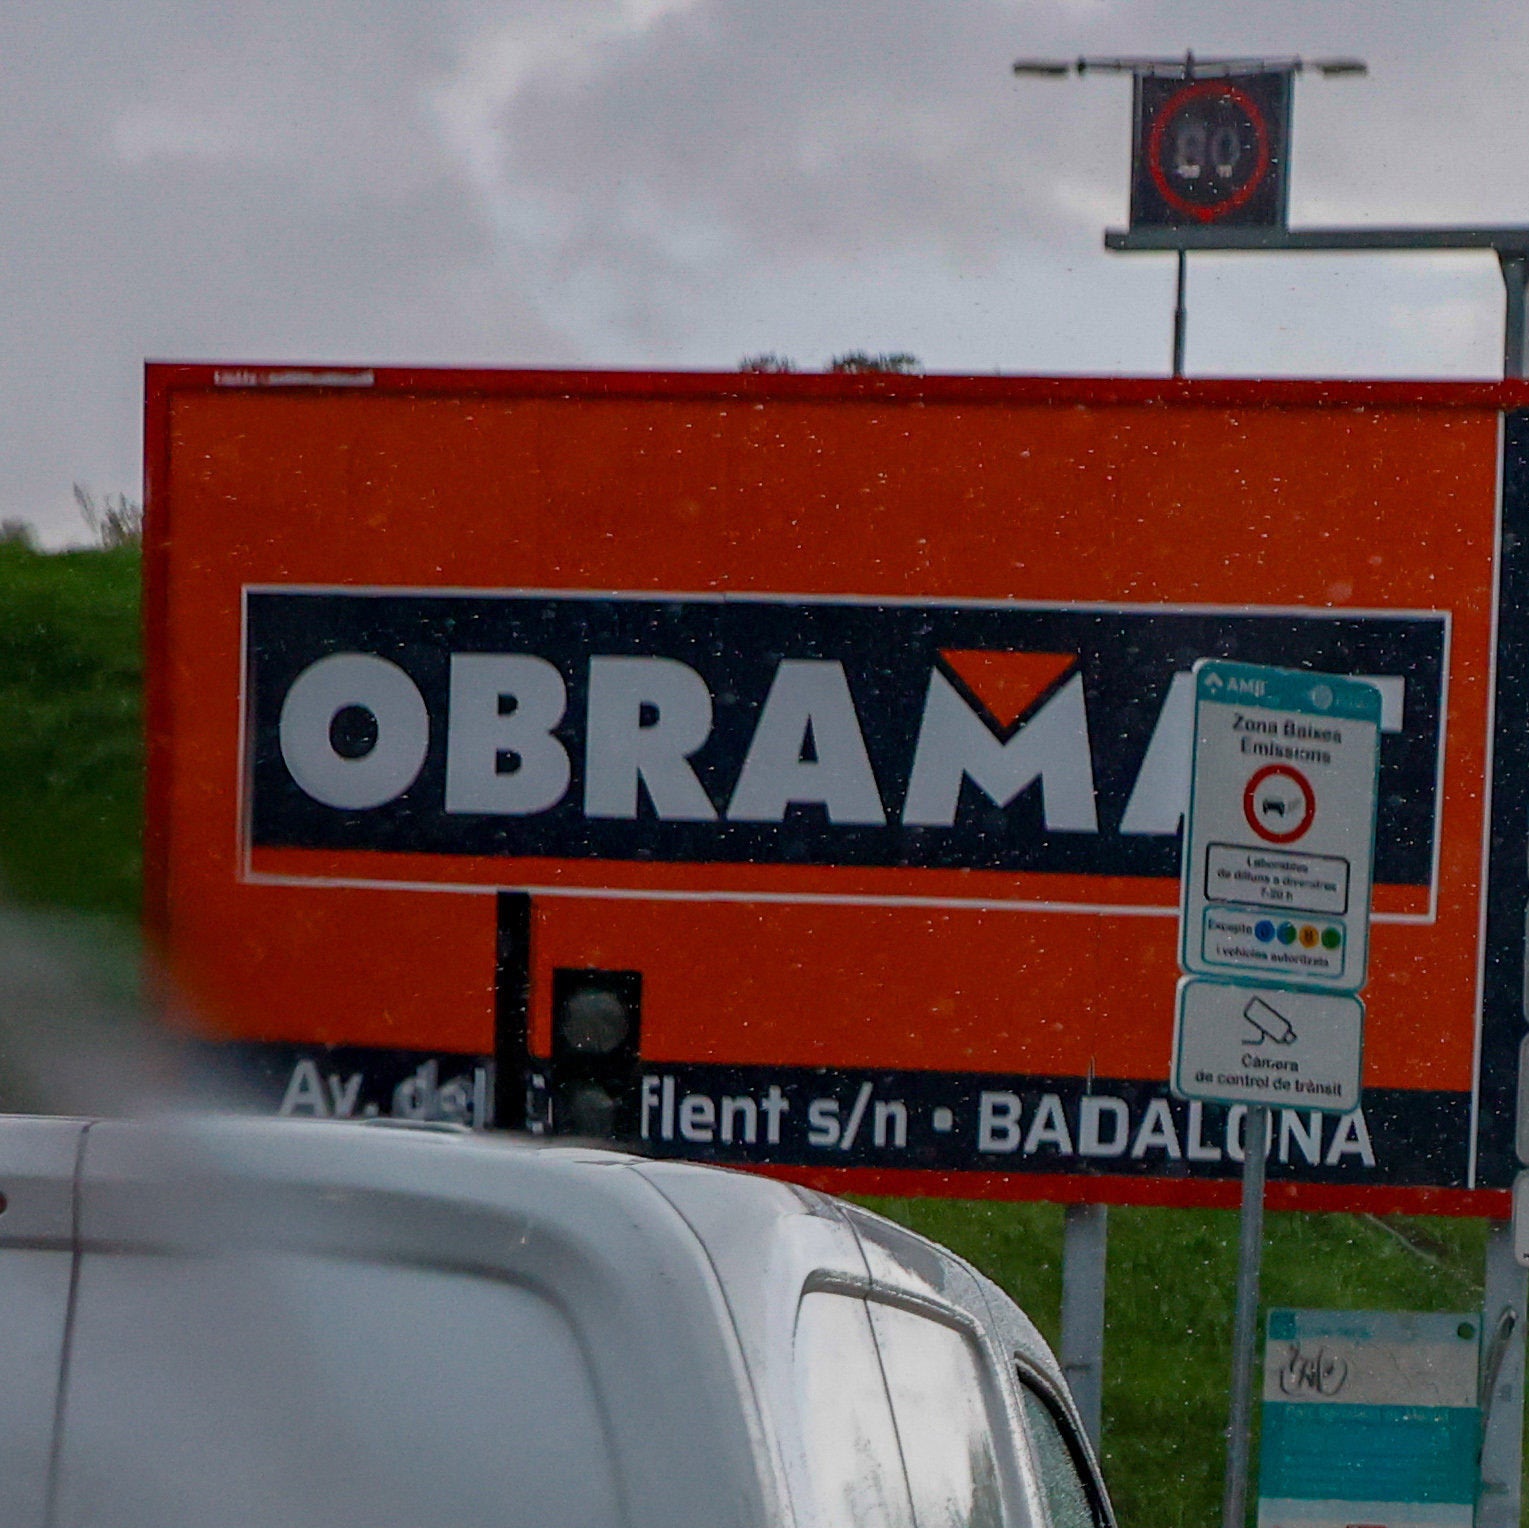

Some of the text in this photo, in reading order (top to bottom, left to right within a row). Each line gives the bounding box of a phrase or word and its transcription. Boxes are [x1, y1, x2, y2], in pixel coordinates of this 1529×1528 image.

[279, 649, 1403, 837] OBRAM
[1232, 712, 1343, 745] Zona Baixes
[1240, 736, 1332, 765] Emissions
[1194, 1068, 1343, 1098] de control de trànsit
[280, 1059, 378, 1117] Av.
[526, 1073, 788, 1146] flent
[808, 1080, 908, 1152] s/n
[977, 1089, 1377, 1168] BADALONA
